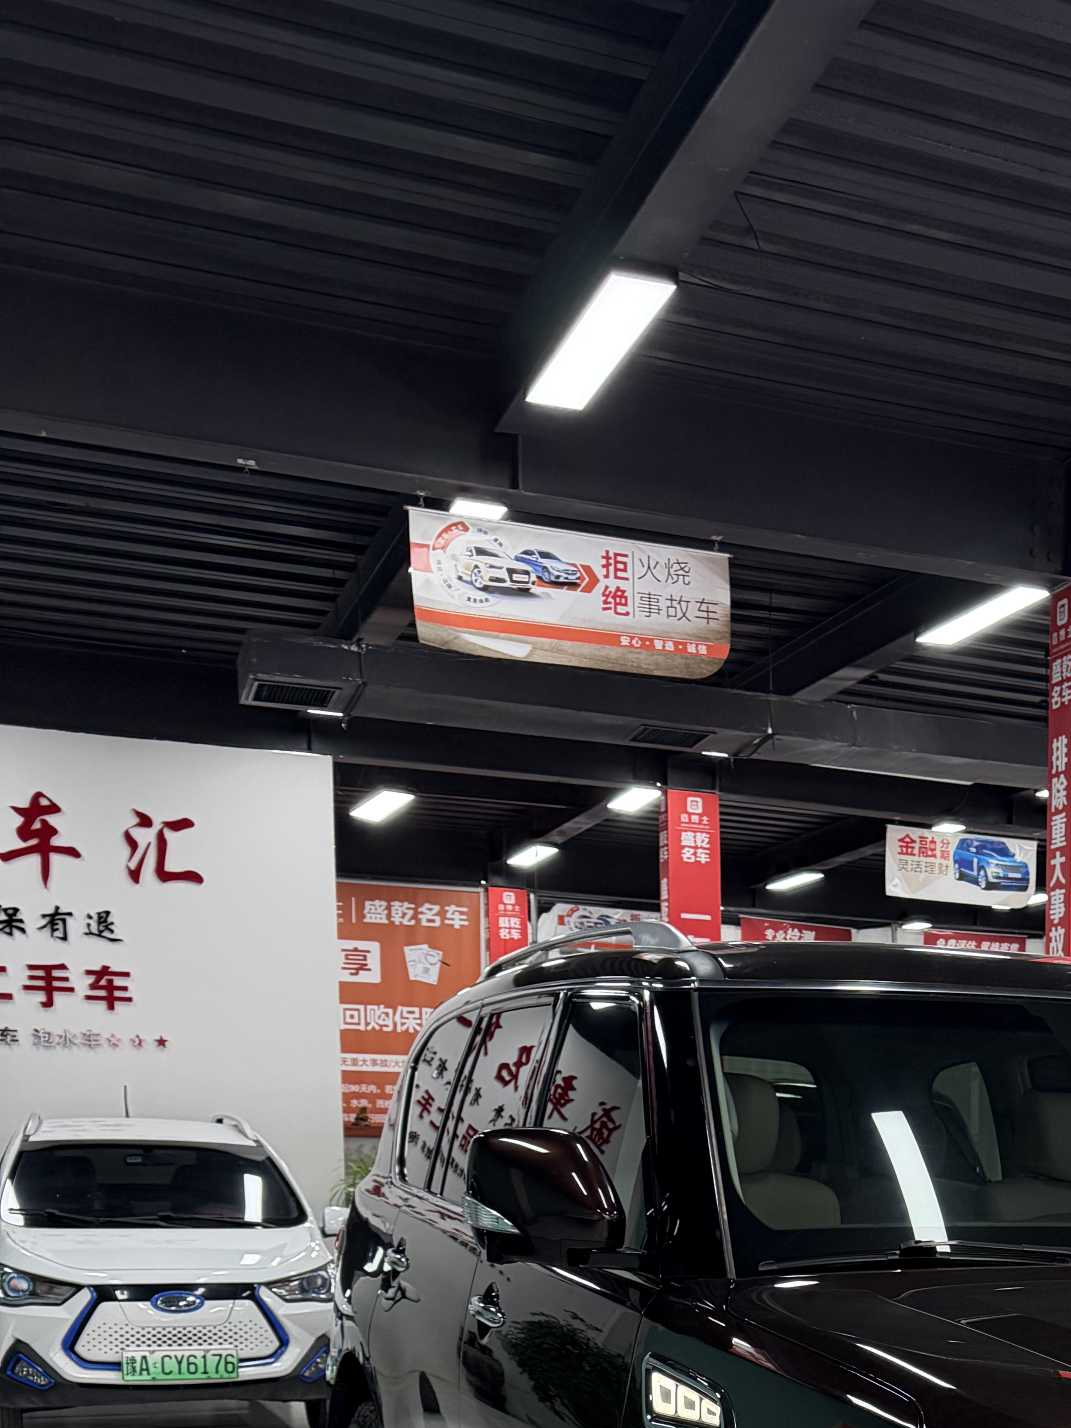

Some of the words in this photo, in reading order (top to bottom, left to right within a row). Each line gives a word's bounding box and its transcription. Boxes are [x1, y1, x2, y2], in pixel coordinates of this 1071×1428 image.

[601, 549, 630, 617] 拒绝
[637, 556, 692, 586] 火烧
[637, 592, 720, 624] 事故车
[897, 833, 937, 858] 金融
[364, 899, 470, 929] 盛乾名车
[341, 947, 372, 976] 享
[0, 963, 133, 1011] 手车
[340, 1004, 434, 1034] 回购保
